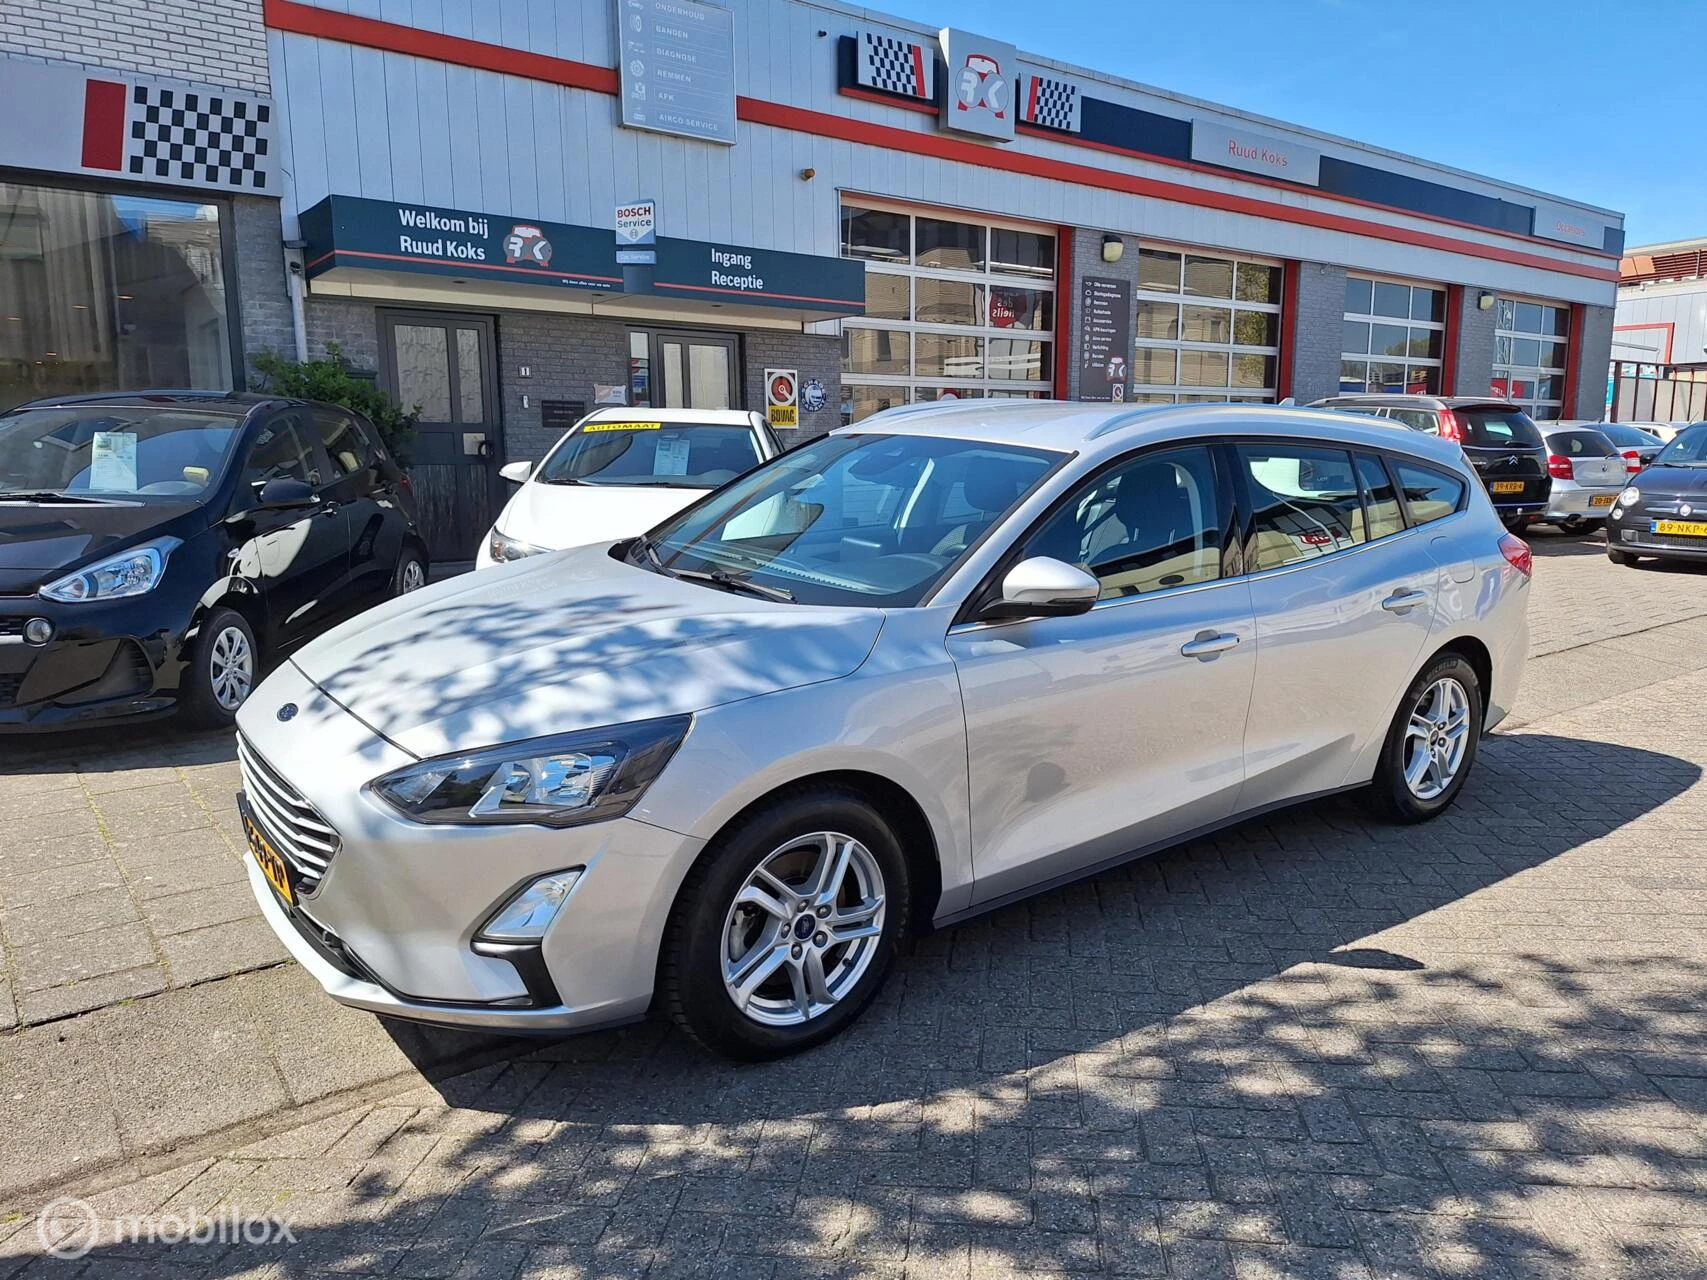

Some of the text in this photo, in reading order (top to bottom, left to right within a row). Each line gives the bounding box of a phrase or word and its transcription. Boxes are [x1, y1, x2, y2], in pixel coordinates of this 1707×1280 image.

[655, 2, 705, 21] ONDERHOUD
[655, 25, 689, 39] BANDEN
[656, 47, 697, 63] DIAGNOSE
[657, 69, 692, 83] REMMEN
[658, 92, 675, 101] APK
[1228, 139, 1288, 168] Ruud Koks
[616, 206, 652, 219] BOSCH
[399, 209, 488, 240] Welkom bij
[617, 218, 652, 228] Service
[400, 235, 486, 260] Ruud Koks
[711, 248, 752, 269] Ingang
[711, 270, 764, 290] Receptie
[770, 408, 795, 423] BOVAG
[587, 423, 657, 432] AUTOMAAT
